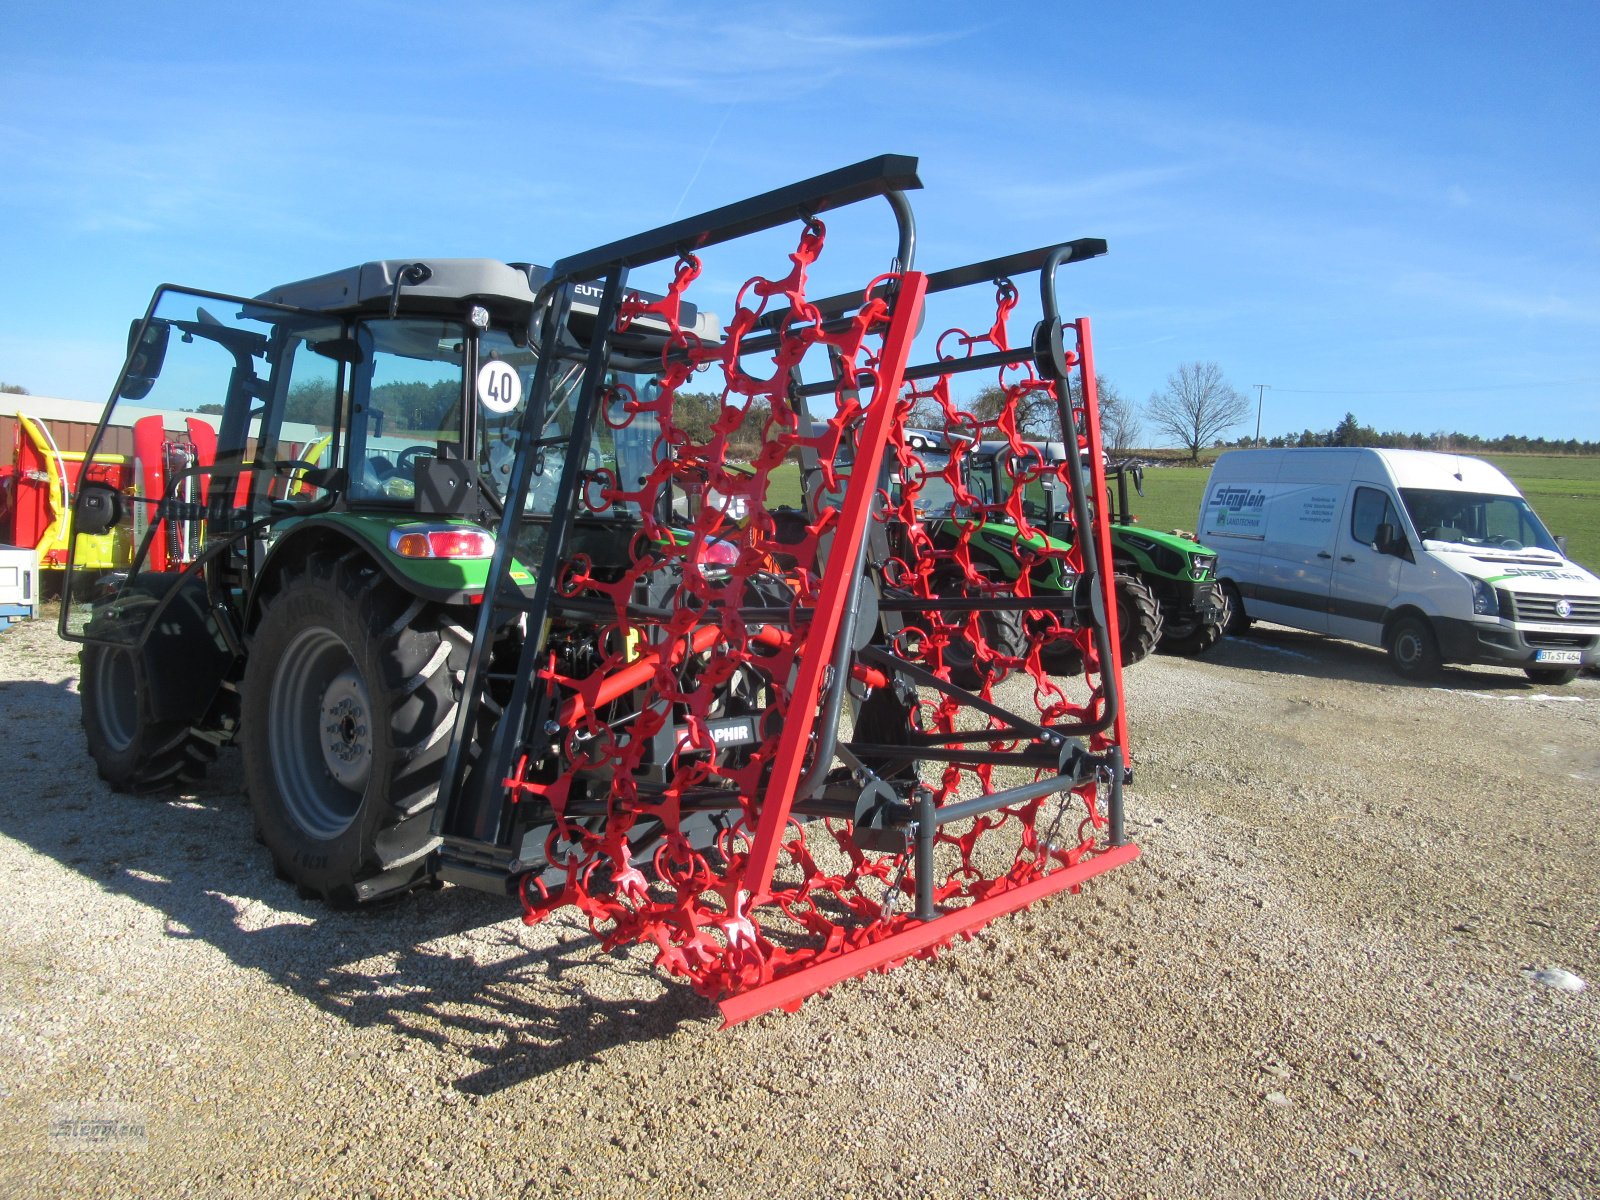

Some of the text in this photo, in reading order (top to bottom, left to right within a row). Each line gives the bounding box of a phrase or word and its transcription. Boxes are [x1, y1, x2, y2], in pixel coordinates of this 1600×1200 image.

[487, 370, 512, 403] 40
[1210, 485, 1266, 512] Stenglein
[1503, 568, 1585, 582] Stenglein
[1541, 651, 1552, 660] BT
[1556, 652, 1566, 660] ST
